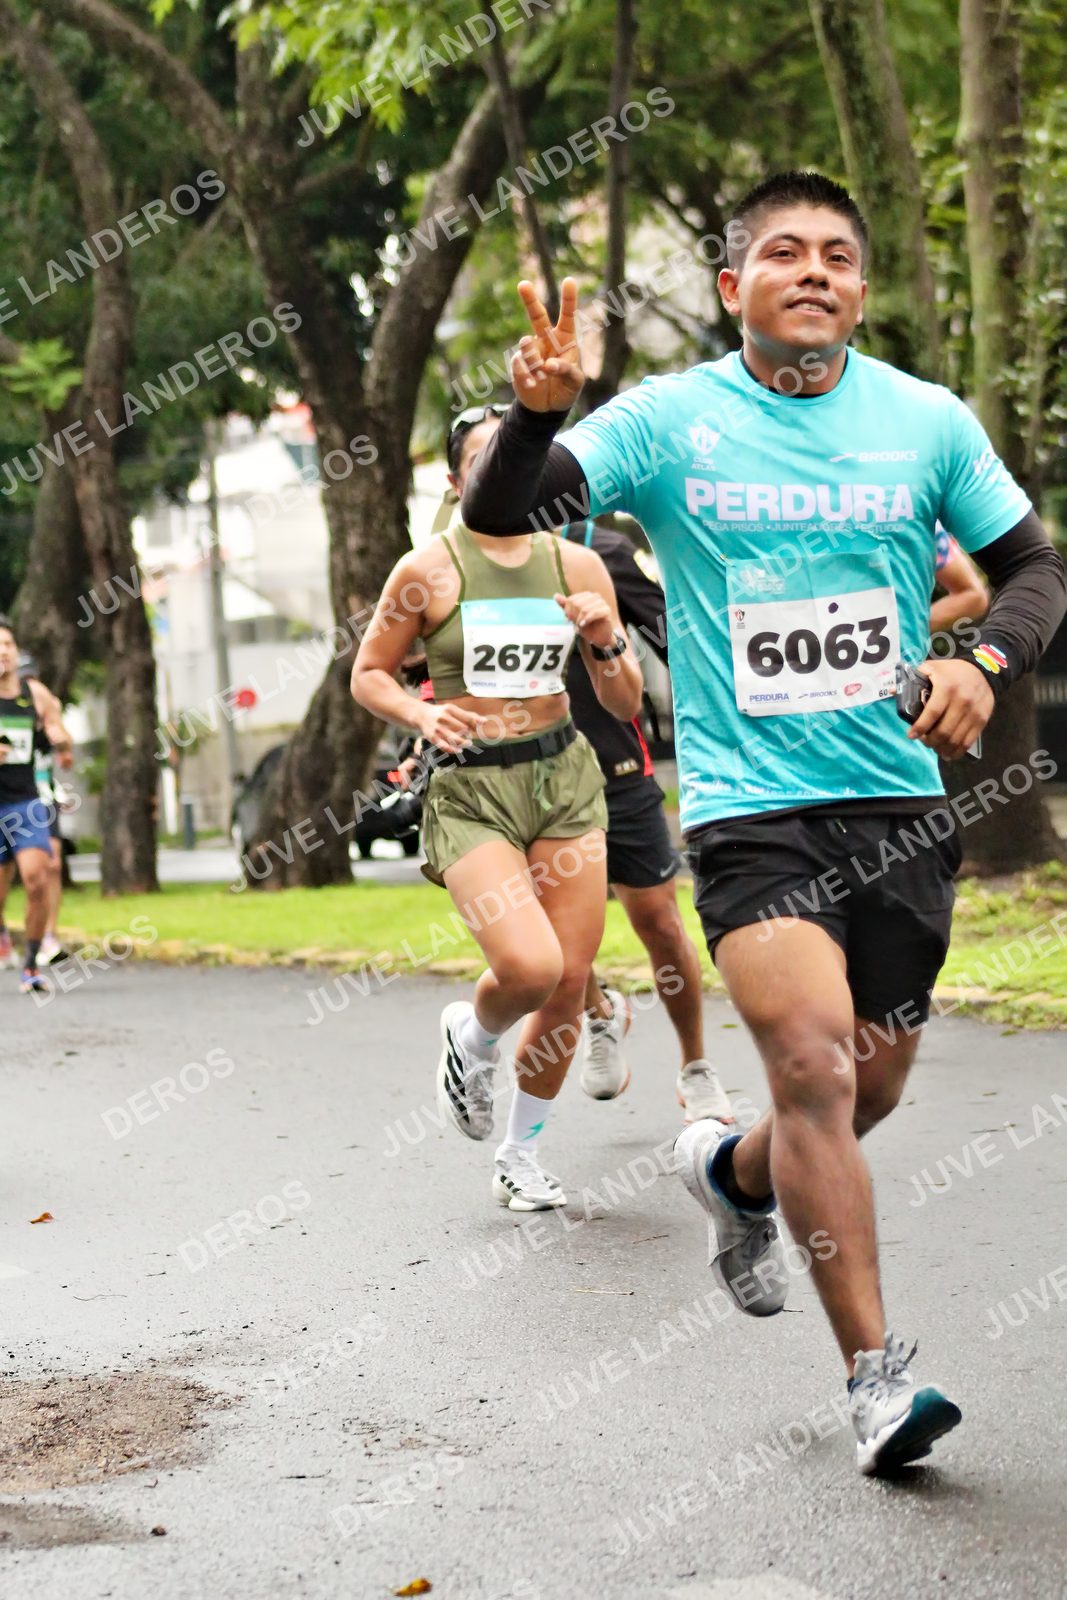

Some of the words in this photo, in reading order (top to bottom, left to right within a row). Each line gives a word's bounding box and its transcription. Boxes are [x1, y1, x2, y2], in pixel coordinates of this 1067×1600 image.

[858, 450, 918, 463] BROOKS
[685, 477, 914, 522] PERDURA
[731, 522, 764, 532] PISOS
[747, 616, 890, 678] 6063
[473, 644, 564, 672] 2673
[749, 692, 789, 702] PERDURA
[809, 690, 837, 698] BROOKS
